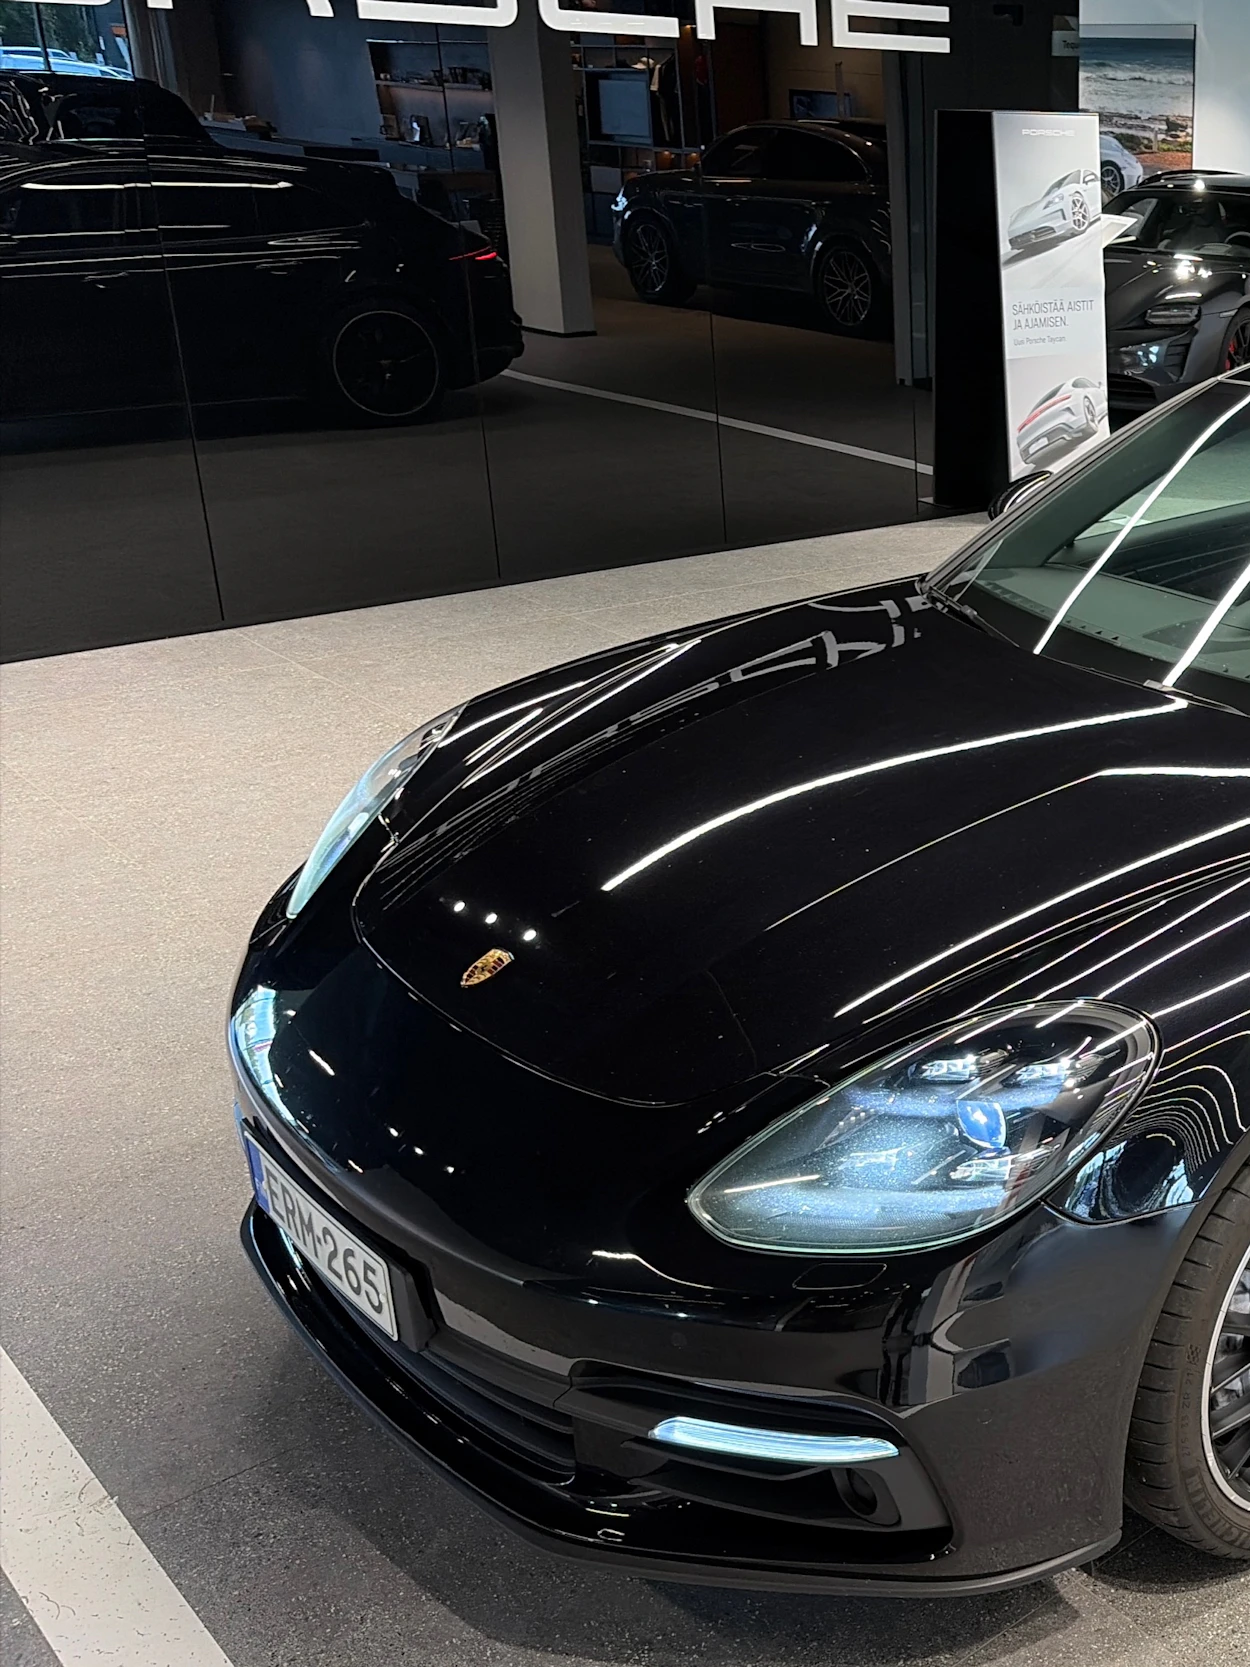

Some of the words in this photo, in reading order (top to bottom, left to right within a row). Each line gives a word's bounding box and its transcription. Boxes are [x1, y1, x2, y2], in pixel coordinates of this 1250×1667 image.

[1022, 129, 1074, 137] PORSCHE
[1012, 299, 1065, 316] SÄHKÖISTÄÄ
[1067, 300, 1094, 313] AISTIT
[1013, 319, 1023, 331] JA
[1024, 316, 1069, 329] AJAMISEN.
[1026, 336, 1046, 345] Porsche
[264, 1165, 383, 1314] ERM-265
